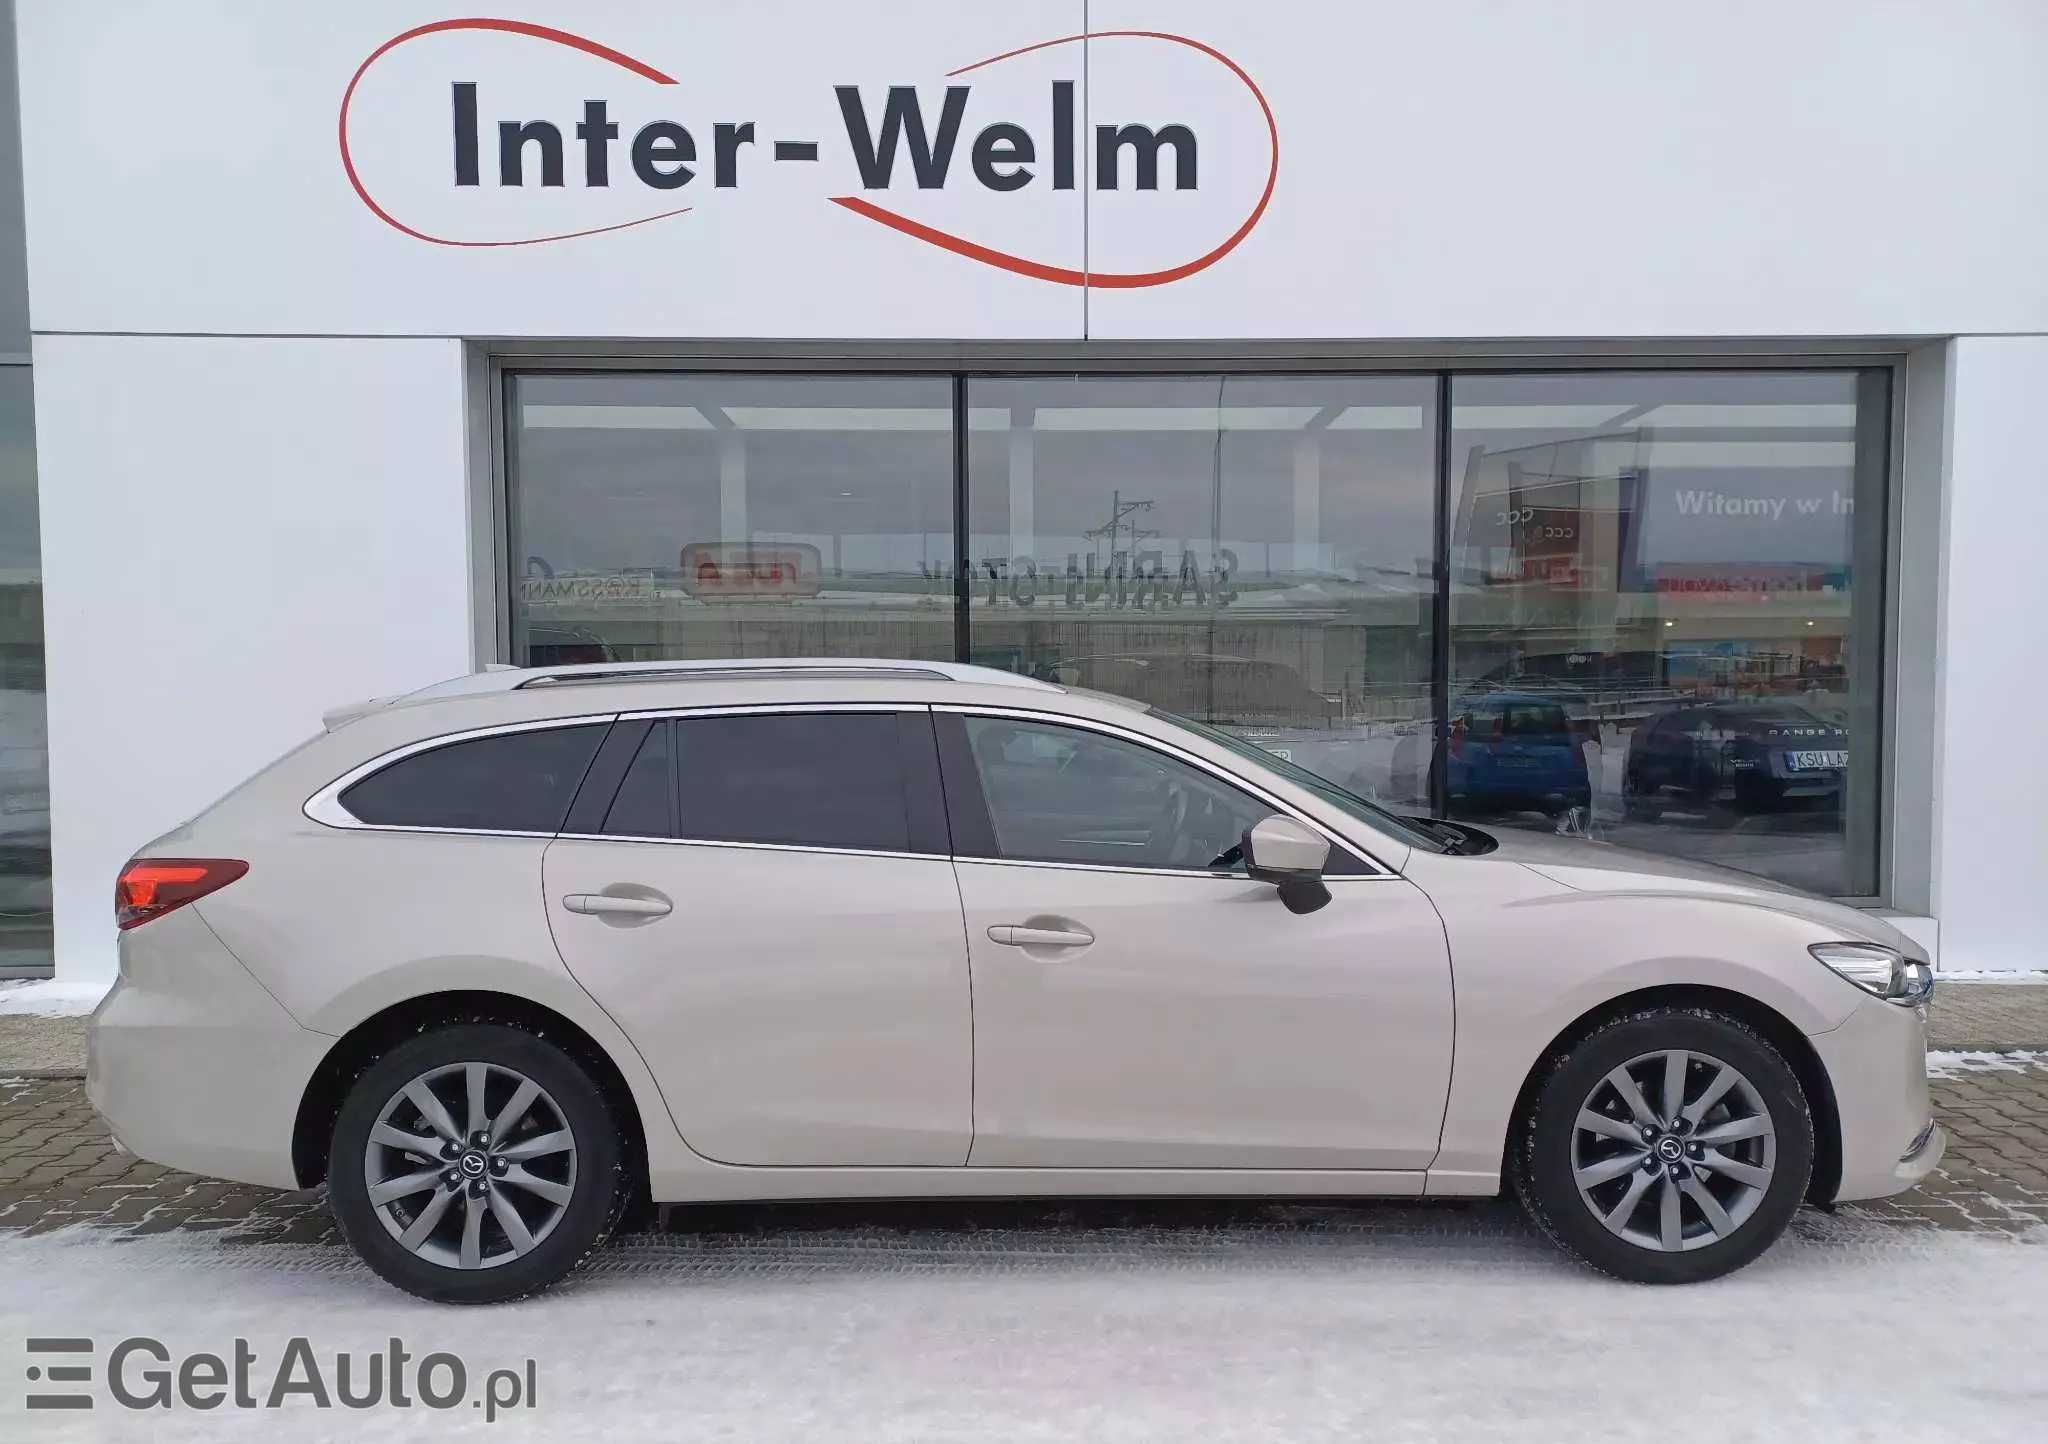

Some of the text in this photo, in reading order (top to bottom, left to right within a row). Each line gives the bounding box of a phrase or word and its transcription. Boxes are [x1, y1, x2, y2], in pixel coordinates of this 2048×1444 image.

[451, 79, 1199, 192] Inter-Welm
[1675, 490, 1787, 521] Witamy
[1796, 500, 1822, 514] w
[1768, 728, 1826, 736] RANGE
[1798, 752, 1824, 767] KSU
